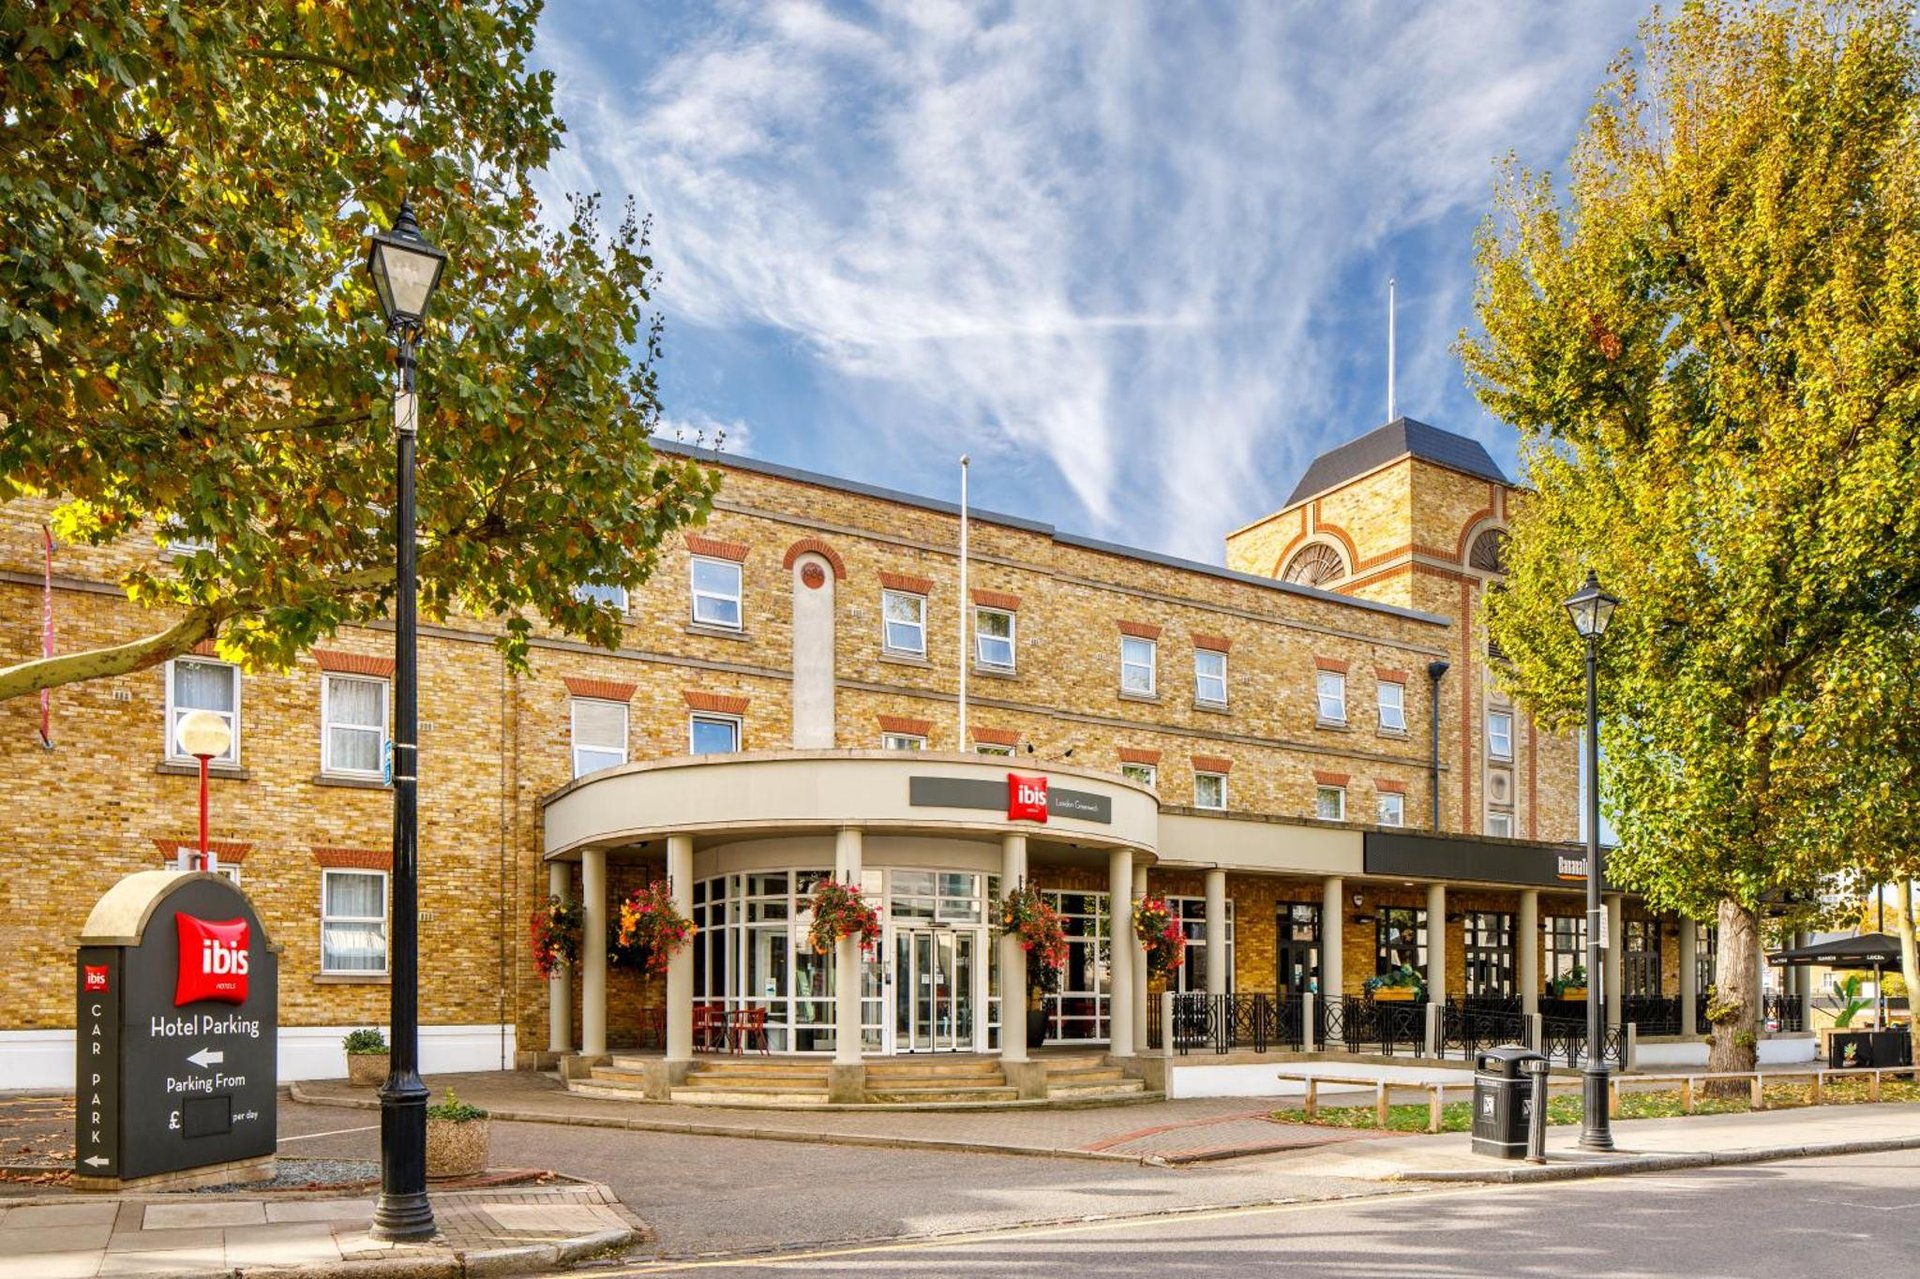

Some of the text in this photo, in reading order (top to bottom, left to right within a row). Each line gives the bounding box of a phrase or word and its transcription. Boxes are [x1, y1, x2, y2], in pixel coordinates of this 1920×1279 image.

[1018, 784, 1047, 806] ibis
[202, 938, 249, 975] ibis
[87, 972, 106, 985] ibis
[151, 1014, 260, 1038] Hotel Parking
[91, 1004, 102, 1144] CAR PARK
[166, 1074, 246, 1093] Parking From
[169, 1110, 259, 1130] £ per day
